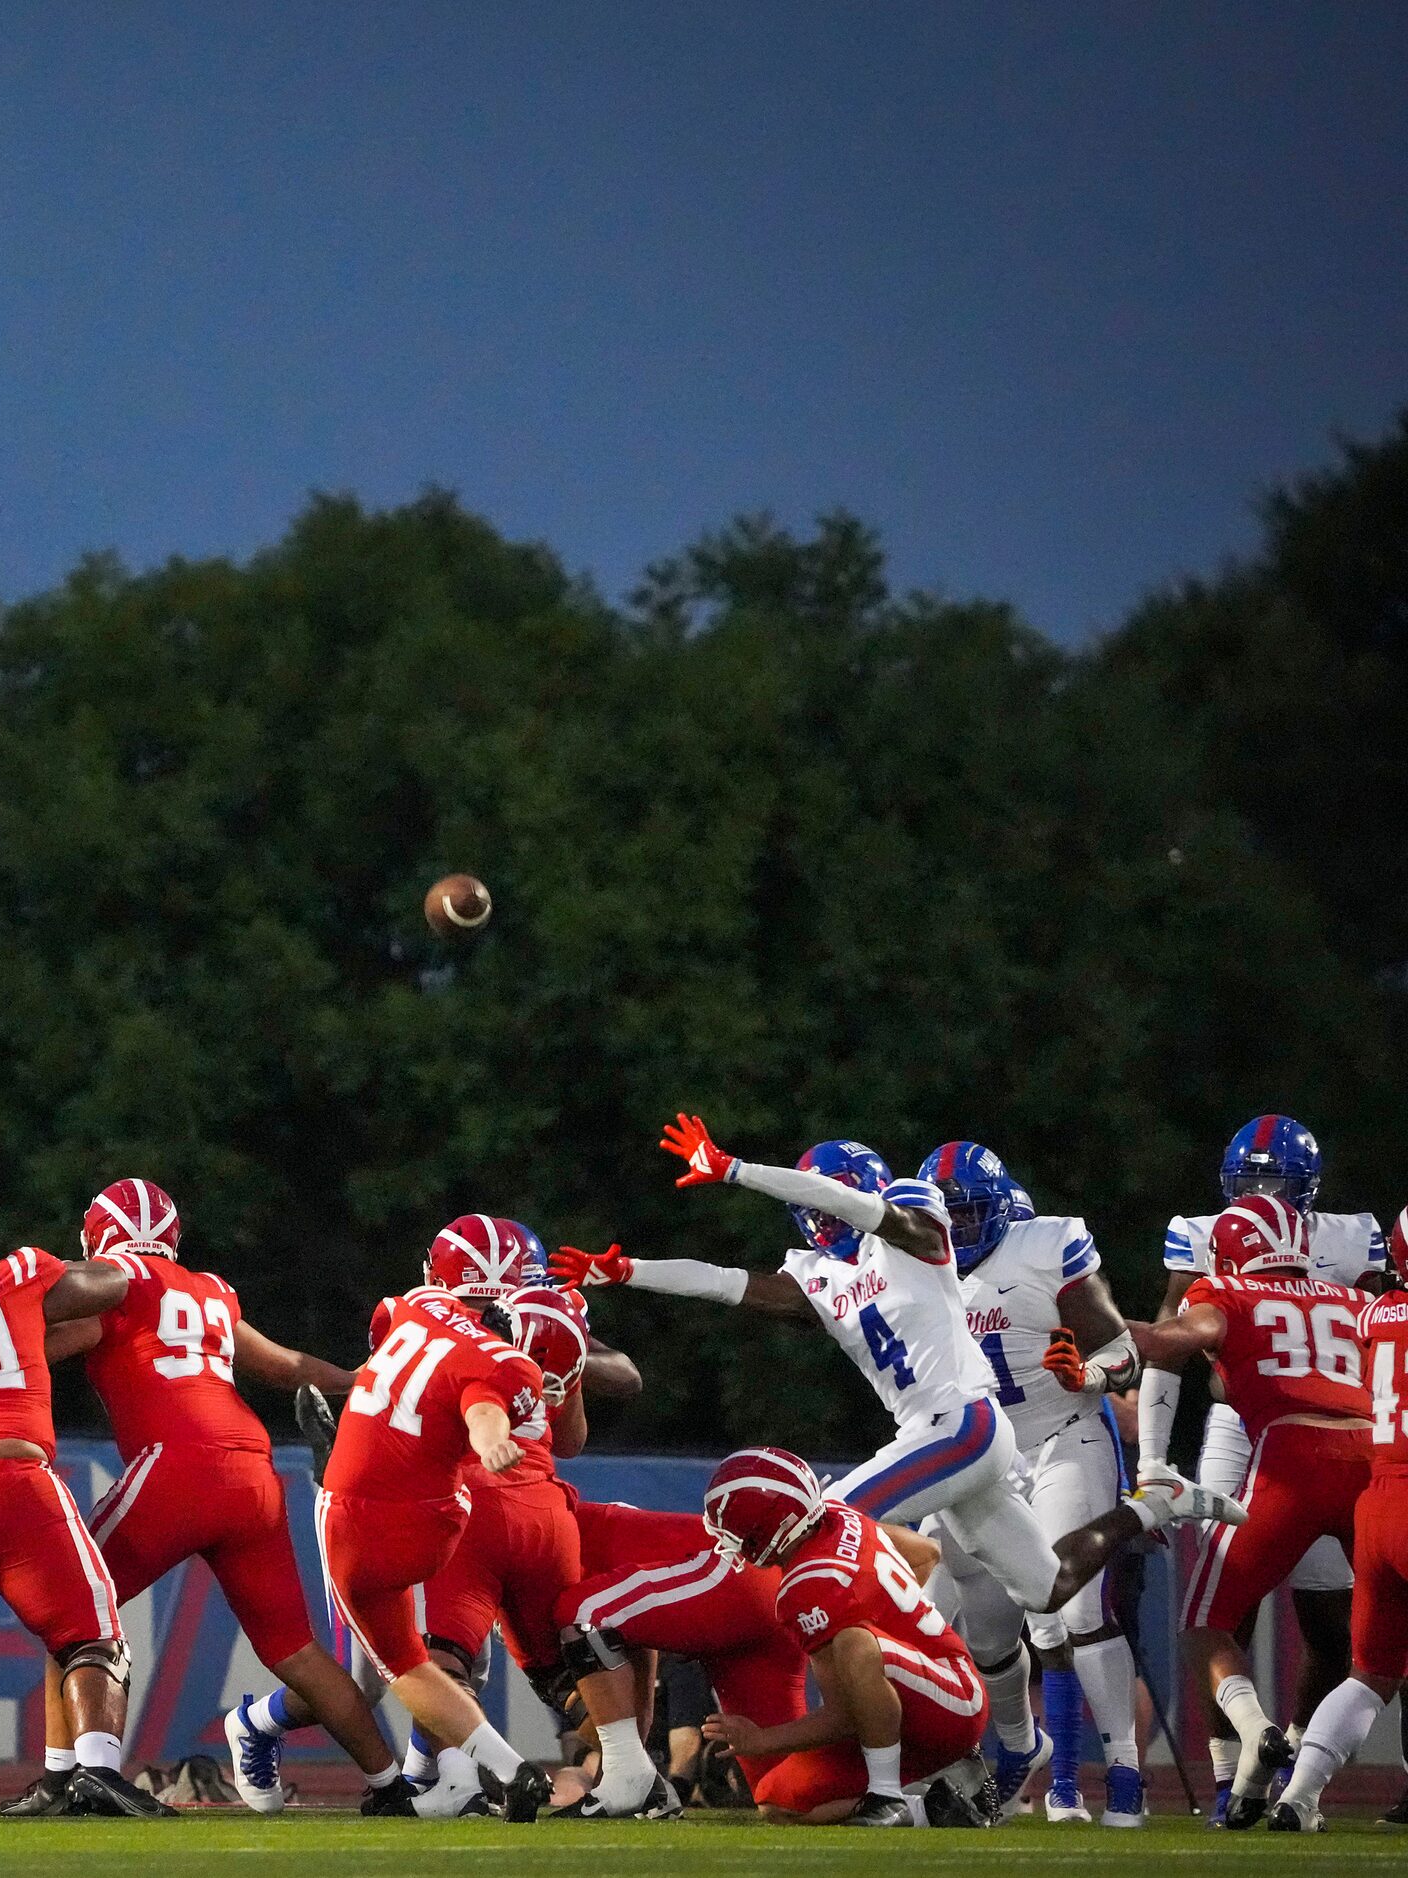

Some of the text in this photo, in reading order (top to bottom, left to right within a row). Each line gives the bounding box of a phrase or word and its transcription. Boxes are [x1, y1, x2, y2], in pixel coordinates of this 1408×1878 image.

[1262, 1255, 1294, 1264] MATER
[469, 1287, 500, 1295] MATER
[833, 1270, 887, 1321] D'Ville
[1245, 1279, 1342, 1298] SHANNON
[1370, 1303, 1408, 1324] MOSQ
[153, 1288, 236, 1387] 93
[965, 1307, 1011, 1335] Ville
[1253, 1299, 1362, 1388] 36
[859, 1303, 916, 1391] 4
[349, 1320, 457, 1437] 91
[1372, 1341, 1408, 1445] 4
